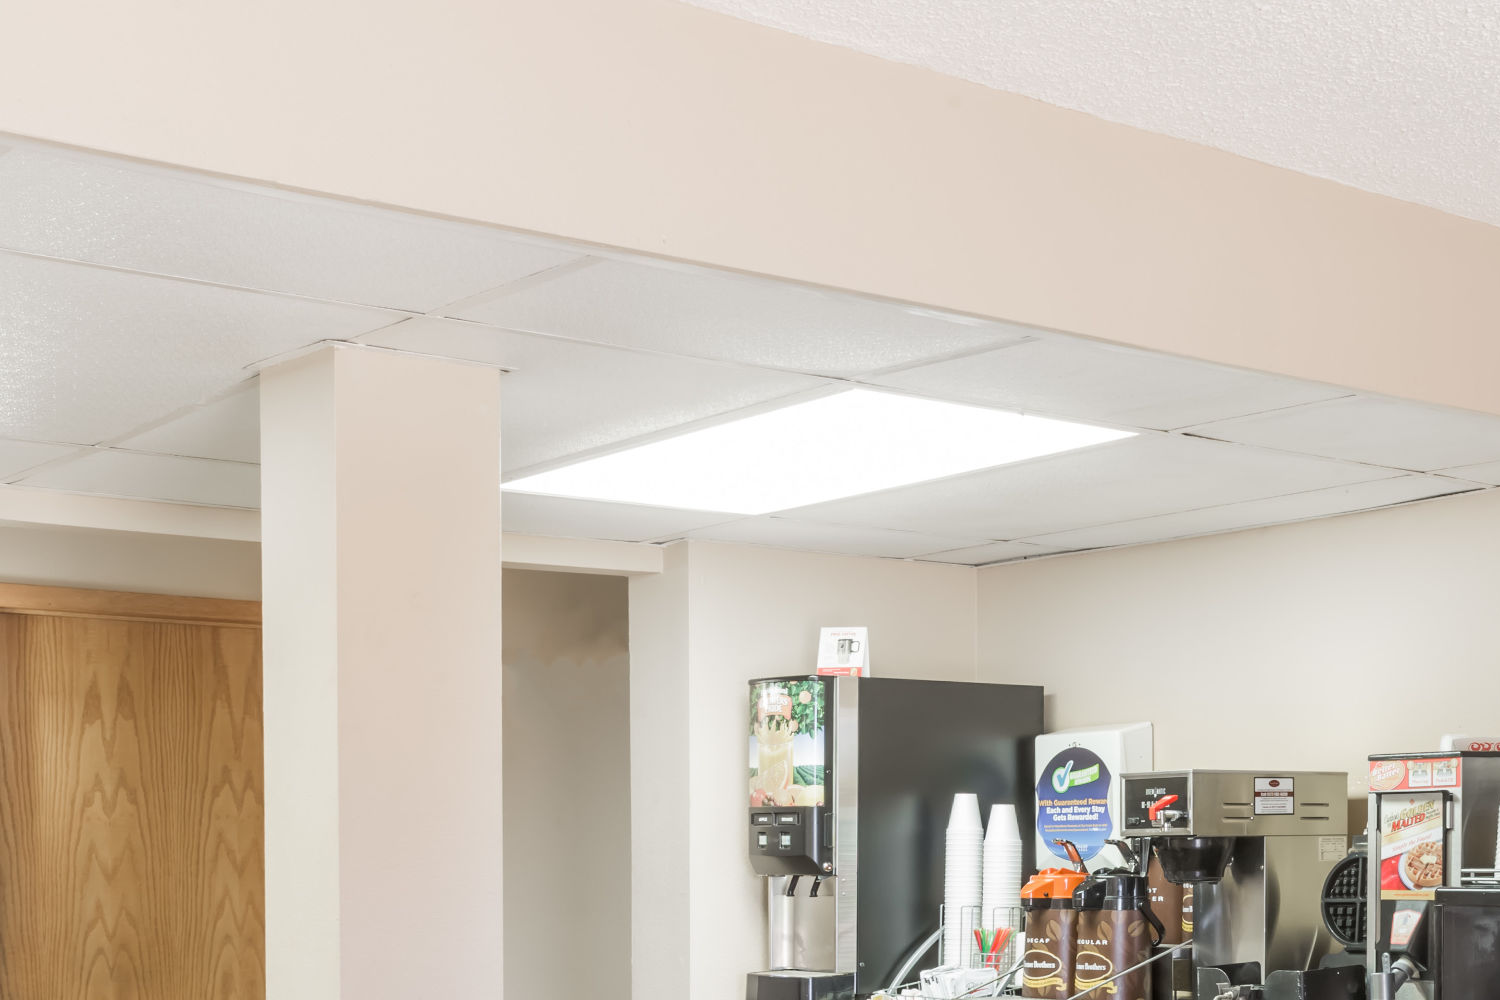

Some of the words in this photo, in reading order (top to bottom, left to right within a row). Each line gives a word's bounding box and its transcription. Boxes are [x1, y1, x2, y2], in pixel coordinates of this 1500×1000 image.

[1039, 799, 1053, 807] With
[1054, 798, 1087, 806] Guaranteed
[1088, 798, 1108, 806] Rewar
[1046, 806, 1061, 814] Each
[1074, 805, 1091, 814] Every
[1091, 805, 1106, 814] Stay
[1053, 813, 1067, 821] Gets
[1067, 813, 1099, 821] Rewarded!
[1391, 812, 1426, 832] MALTED
